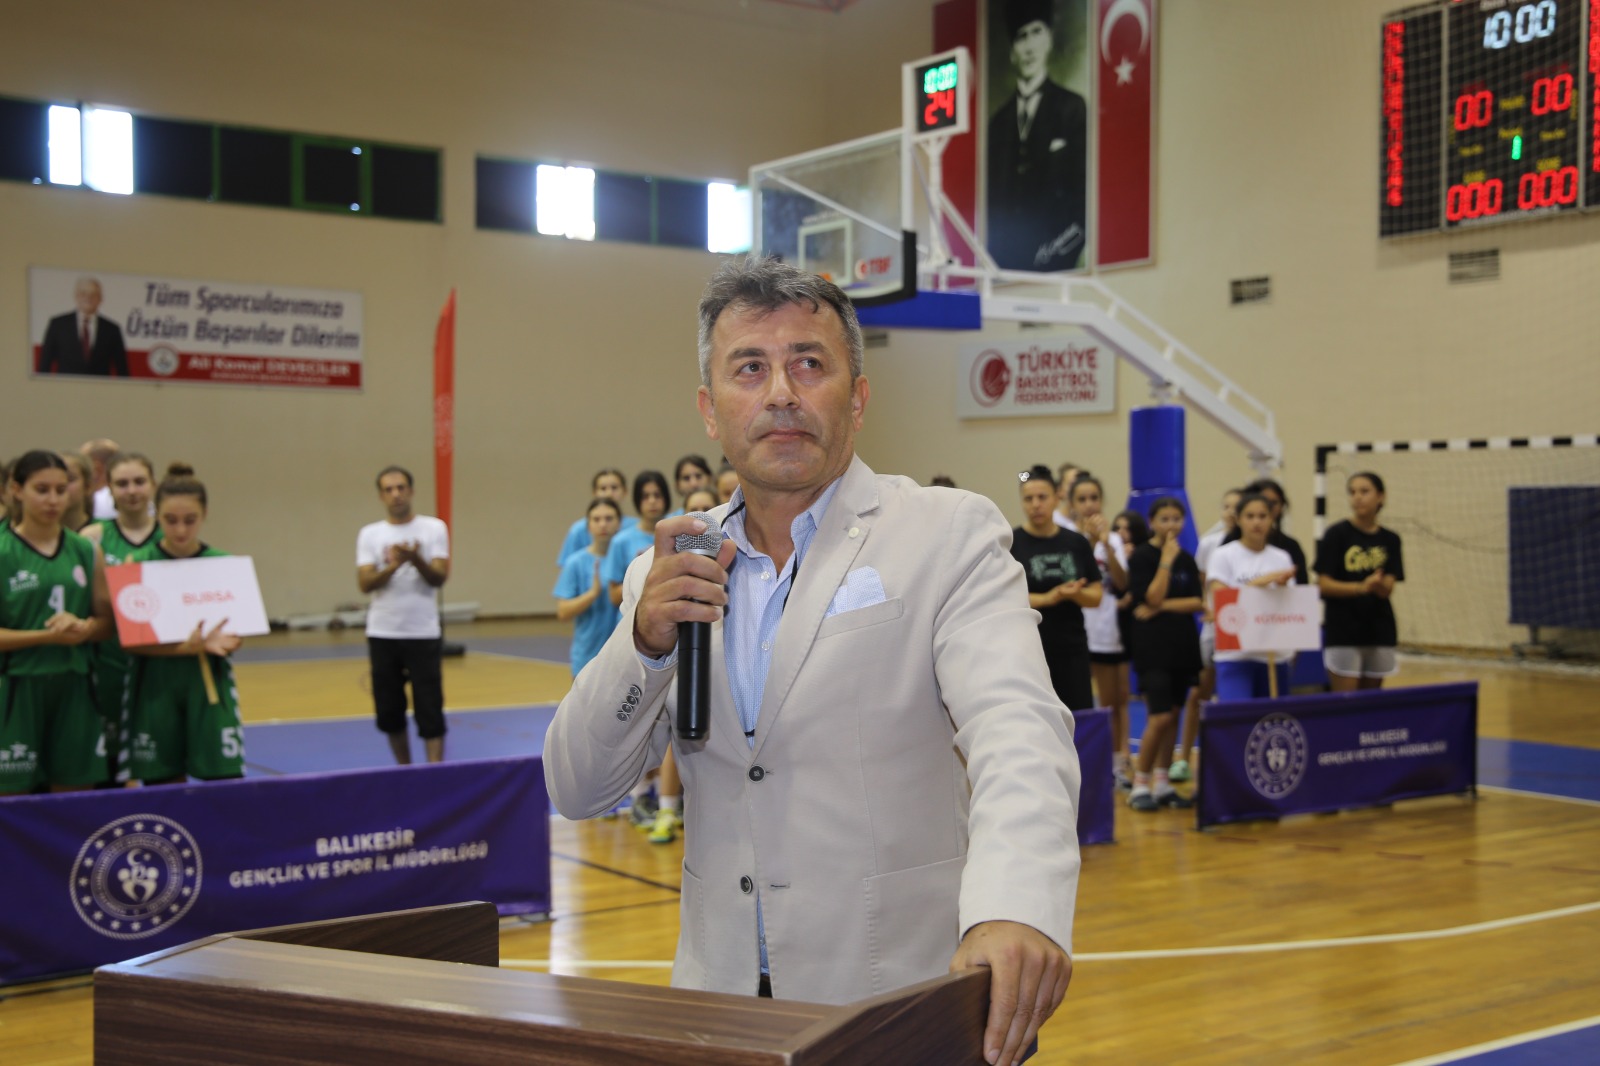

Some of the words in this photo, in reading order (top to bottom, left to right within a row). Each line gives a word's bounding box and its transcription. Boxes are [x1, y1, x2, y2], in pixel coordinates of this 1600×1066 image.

[925, 89, 955, 125] 24
[1454, 90, 1493, 131] 00
[1532, 73, 1573, 116] 00
[1512, 135, 1522, 160] 1
[1446, 178, 1503, 221] 000
[1518, 166, 1578, 210] 000
[145, 282, 190, 308] Tüm
[196, 286, 343, 319] Sporcularımıza
[126, 308, 188, 338] Üstün
[195, 319, 285, 346] Başarılar
[291, 324, 359, 348] Dilerim
[1016, 343, 1098, 373] TÜRKİYE
[1016, 373, 1097, 389] BASKETBOL
[182, 590, 235, 606] BURSA
[316, 827, 415, 857] BALIKESİR
[229, 862, 304, 888] GENÇLİK
[306, 861, 330, 879] VE
[332, 857, 374, 878] SPOR
[392, 840, 488, 869] MÜDÜRLÜĞÜ
